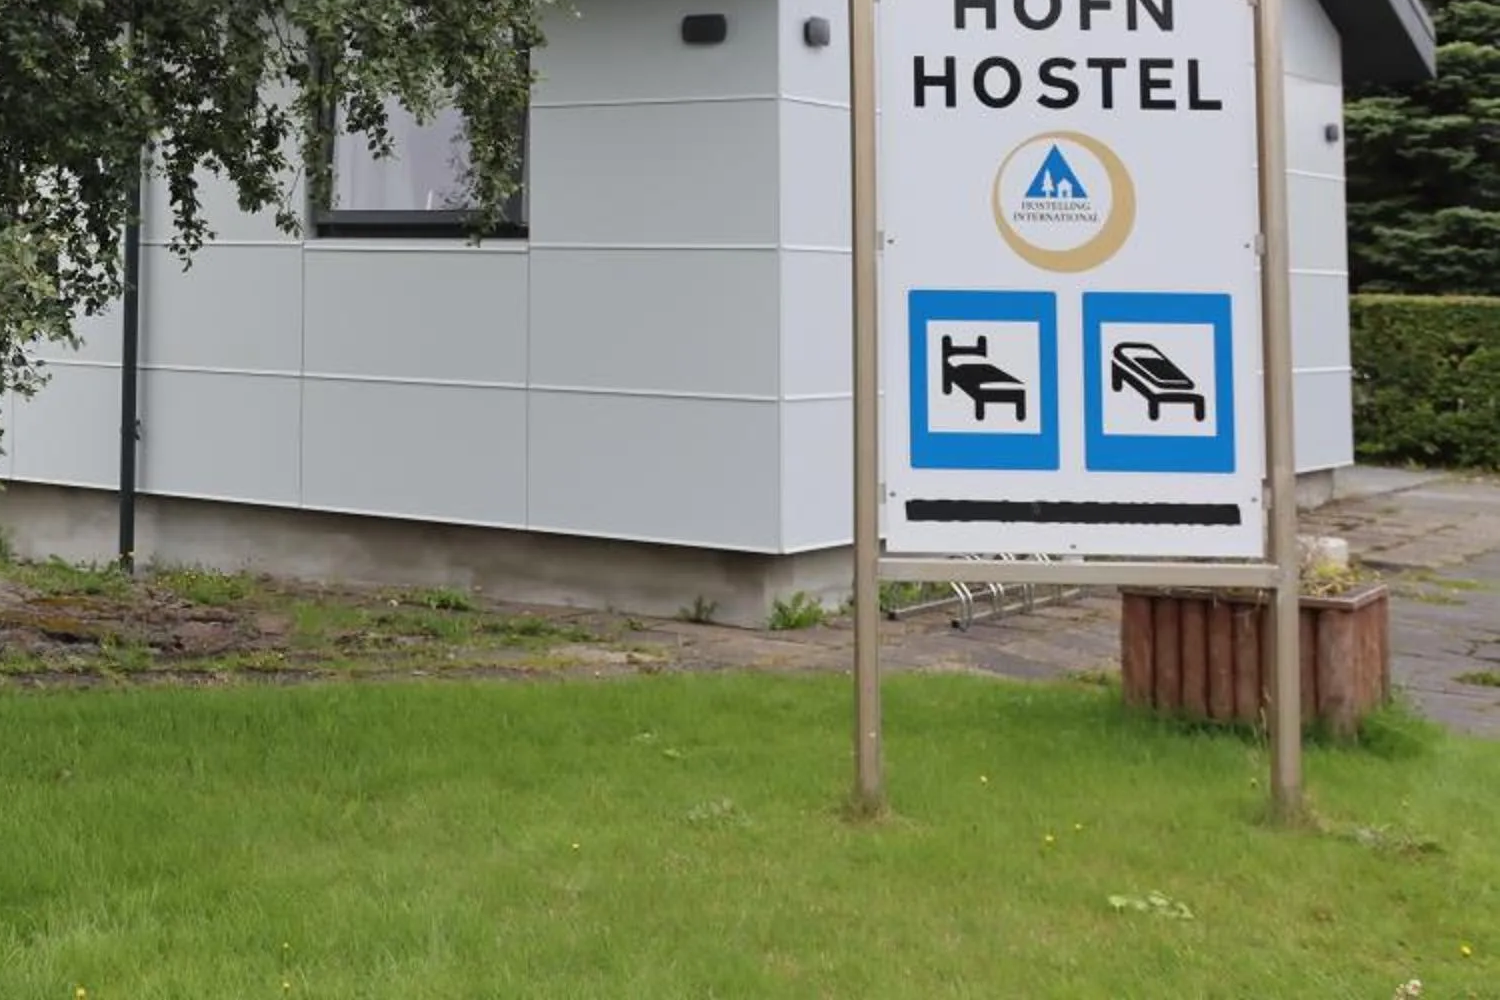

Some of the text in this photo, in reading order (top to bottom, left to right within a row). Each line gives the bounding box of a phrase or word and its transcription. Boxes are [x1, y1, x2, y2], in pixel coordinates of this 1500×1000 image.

[912, 55, 1224, 111] HOSTEL
[1021, 201, 1091, 211] HOSTELLING
[1013, 211, 1098, 222] INTERNATIONAL
